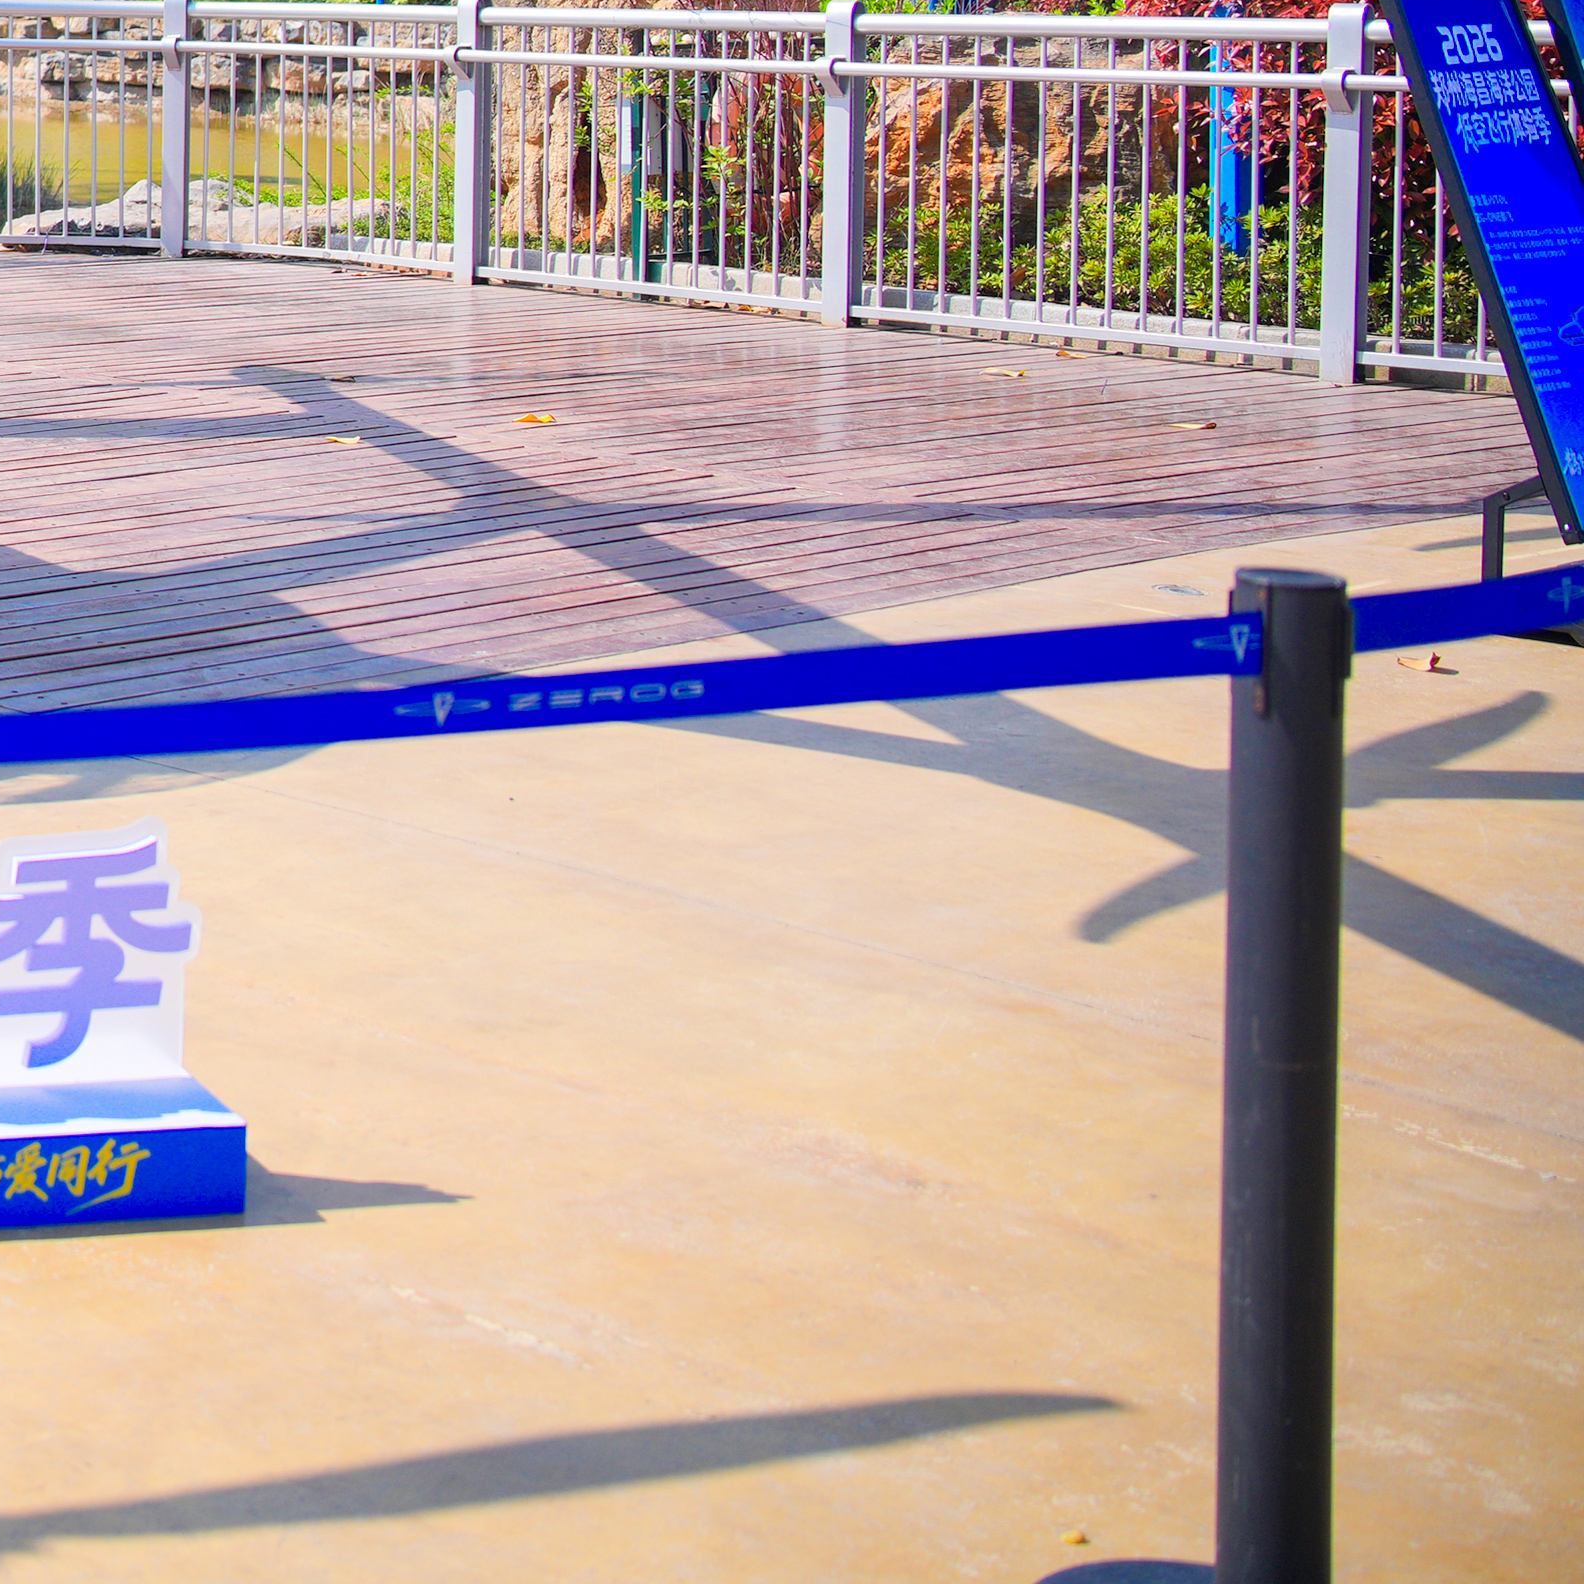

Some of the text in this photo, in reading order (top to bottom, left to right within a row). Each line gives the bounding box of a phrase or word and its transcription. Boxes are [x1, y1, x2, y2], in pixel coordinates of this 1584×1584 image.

[1436, 24, 1503, 64] 2026
[1429, 68, 1540, 116] 郑州海昌海洋公园
[1456, 106, 1552, 154] 低空飞行体验季
[507, 678, 706, 712] ZEROG
